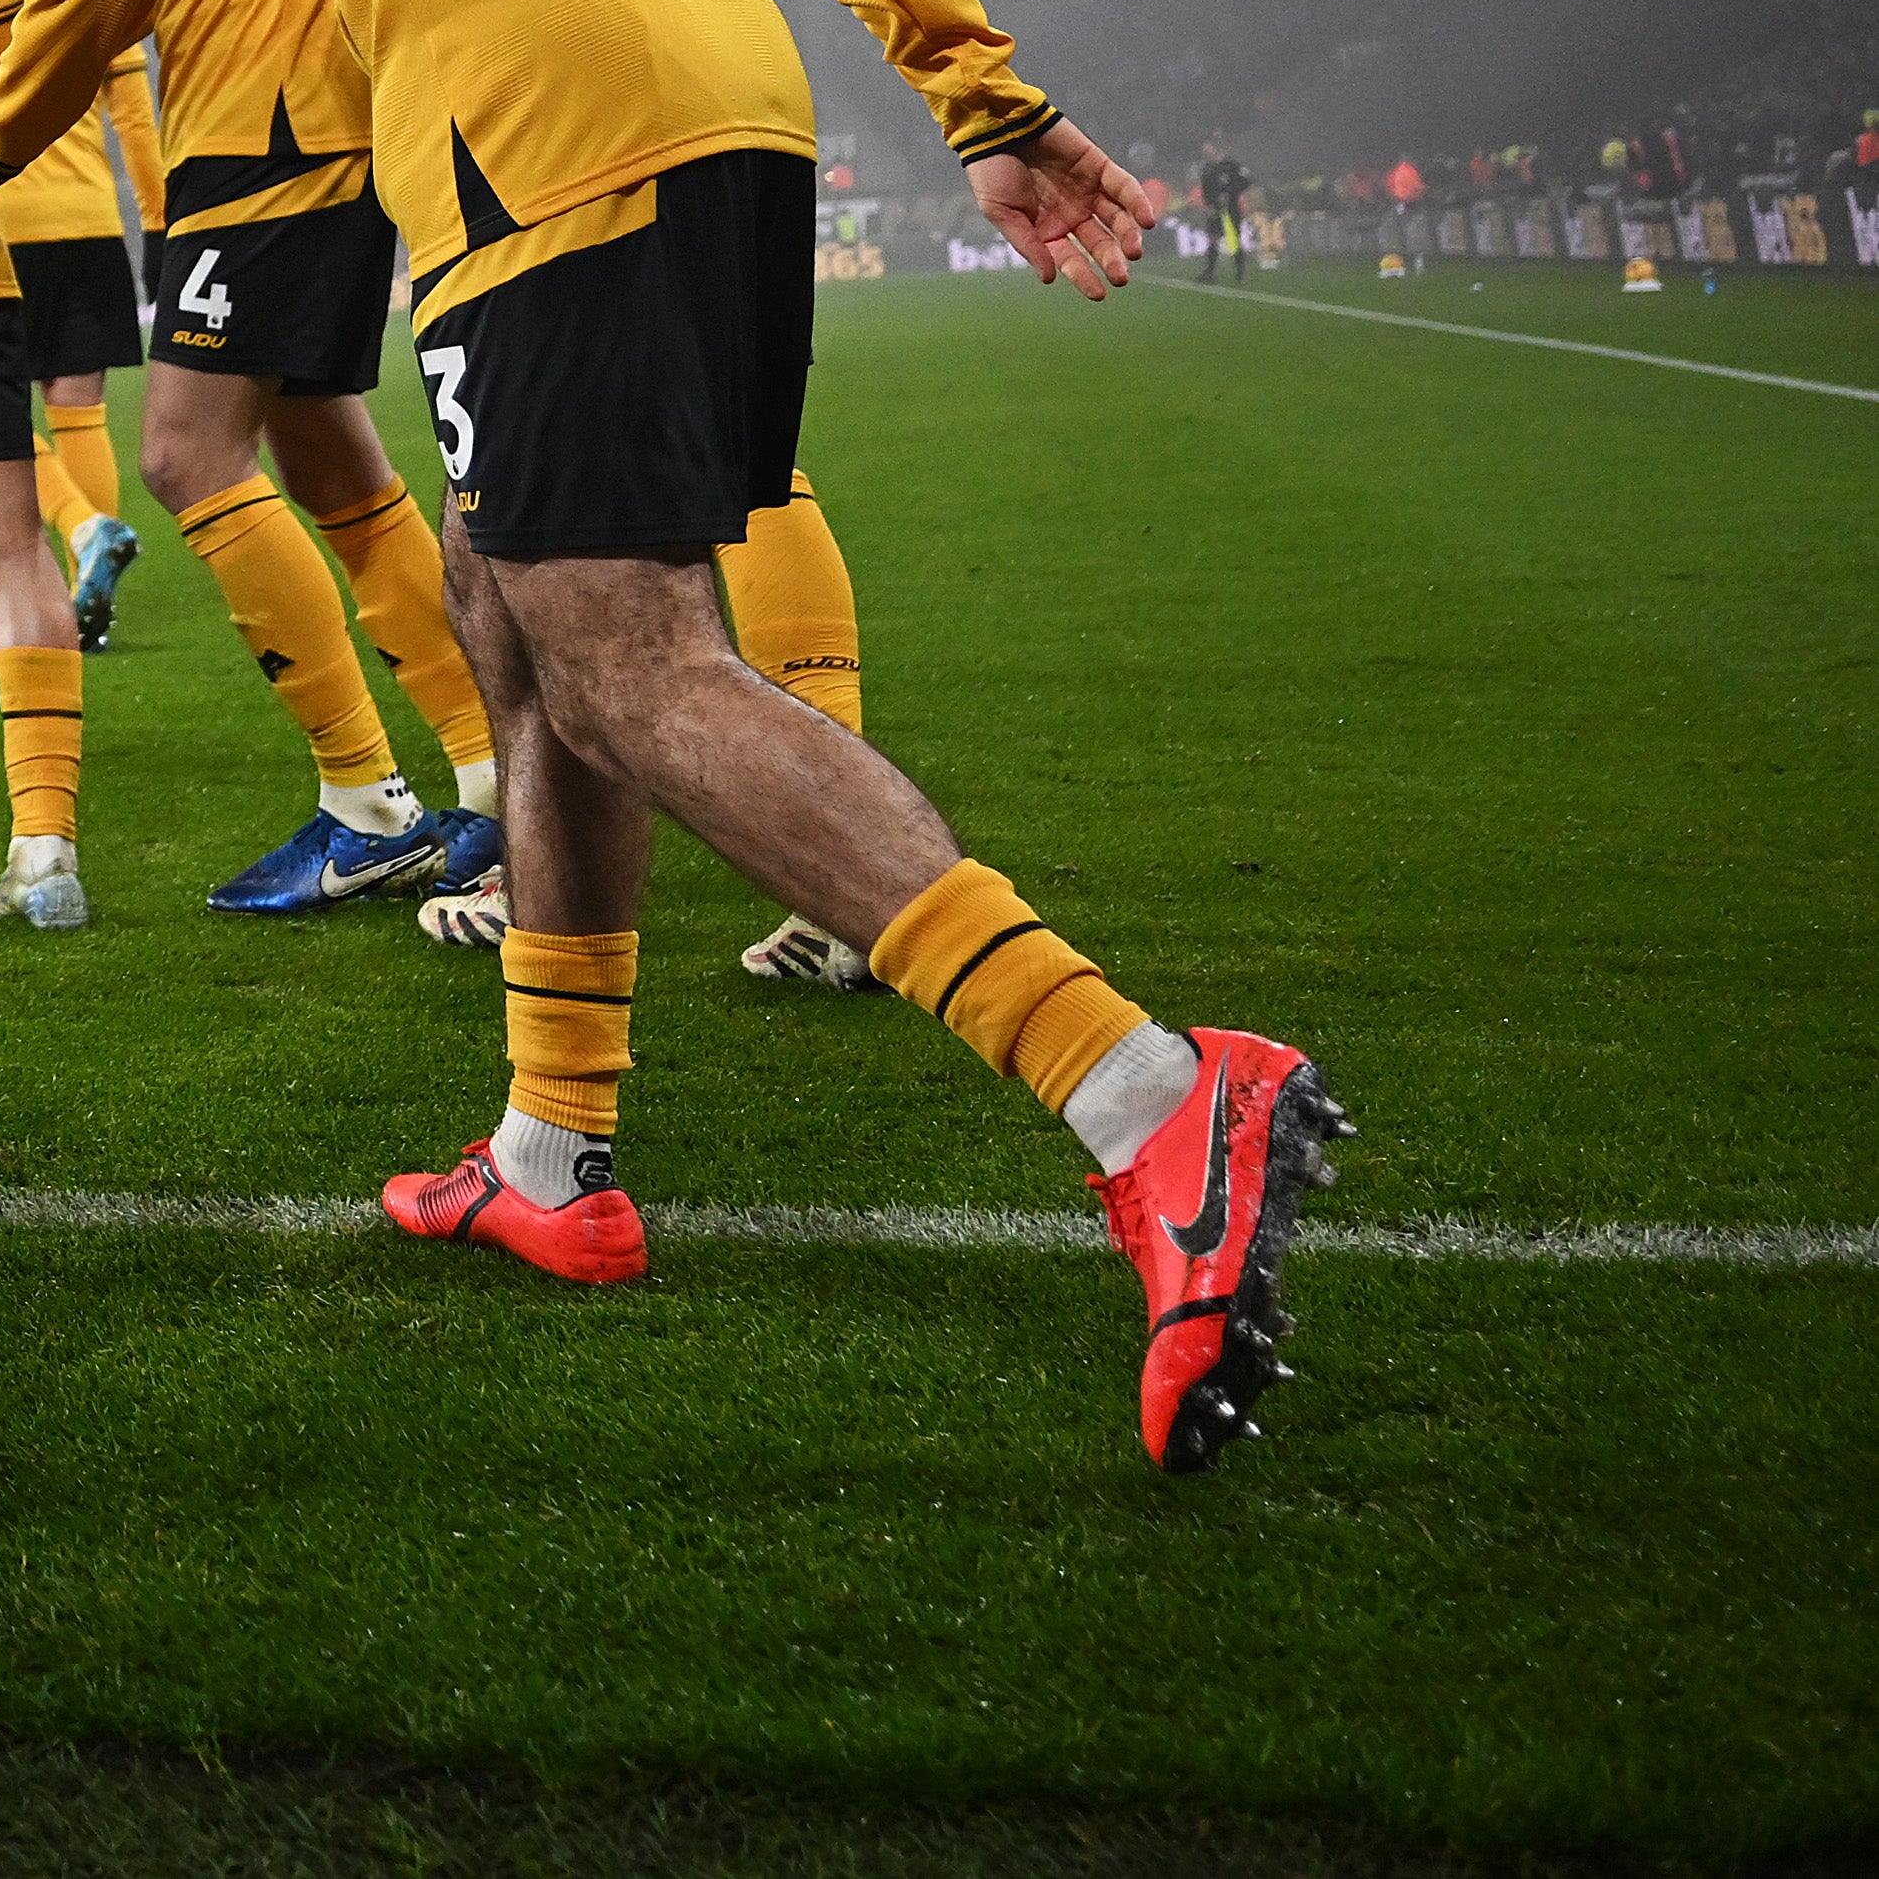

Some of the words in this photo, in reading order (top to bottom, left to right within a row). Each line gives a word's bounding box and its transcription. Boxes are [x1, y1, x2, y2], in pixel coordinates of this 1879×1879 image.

[178, 248, 233, 330] 4
[171, 329, 228, 350] SUDU
[420, 345, 474, 481] 3
